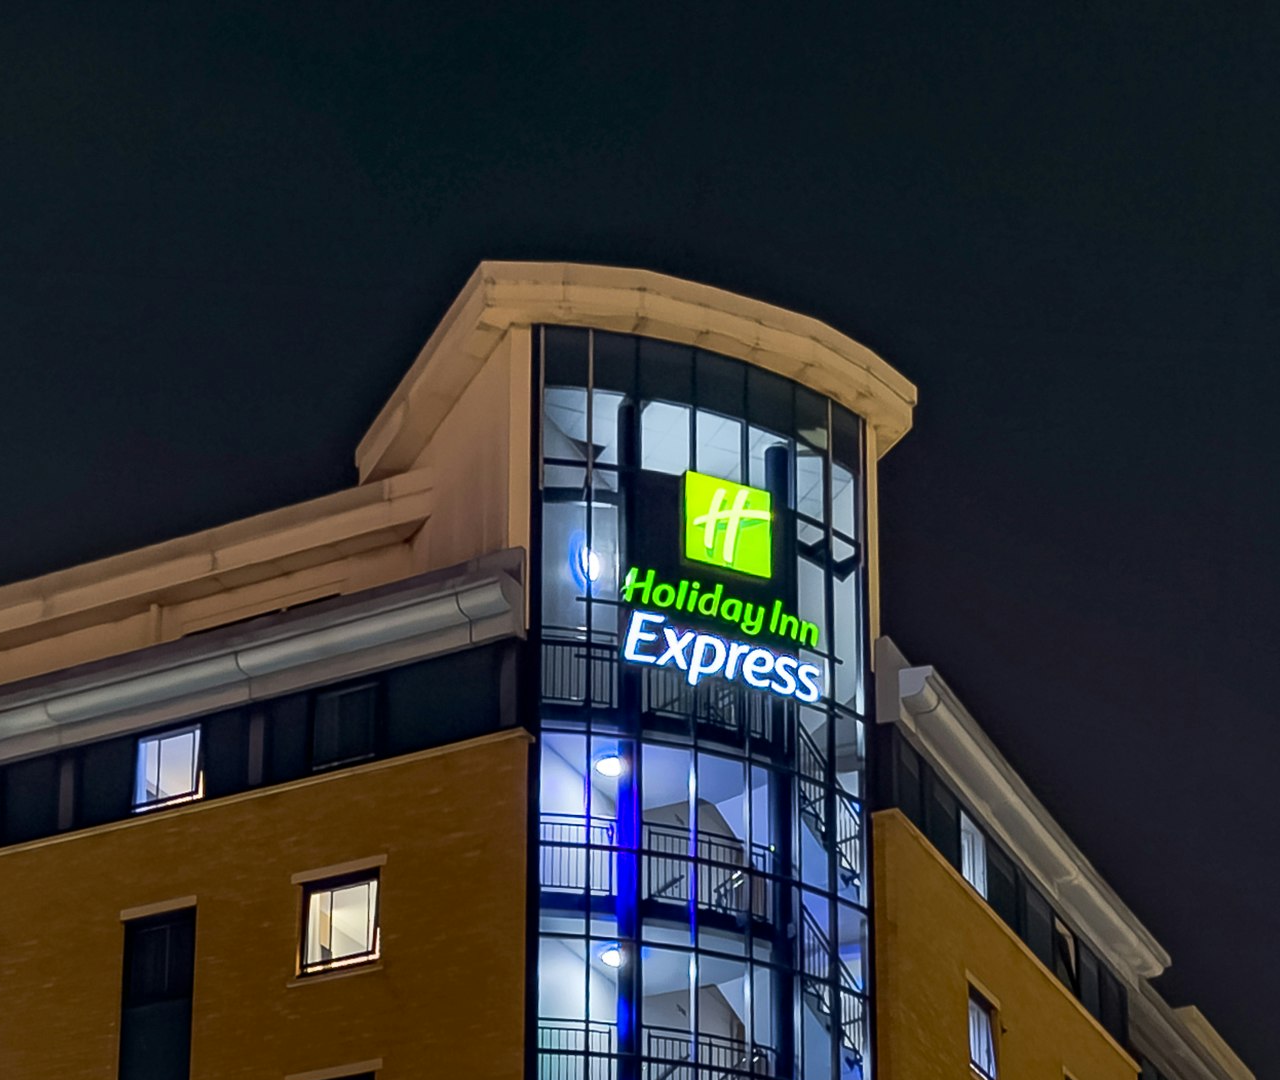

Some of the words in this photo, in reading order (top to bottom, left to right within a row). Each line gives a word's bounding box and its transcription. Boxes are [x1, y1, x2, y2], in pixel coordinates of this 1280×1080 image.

[622, 567, 765, 636] Holiday
[770, 600, 820, 648] Inn
[623, 609, 821, 703] Express
